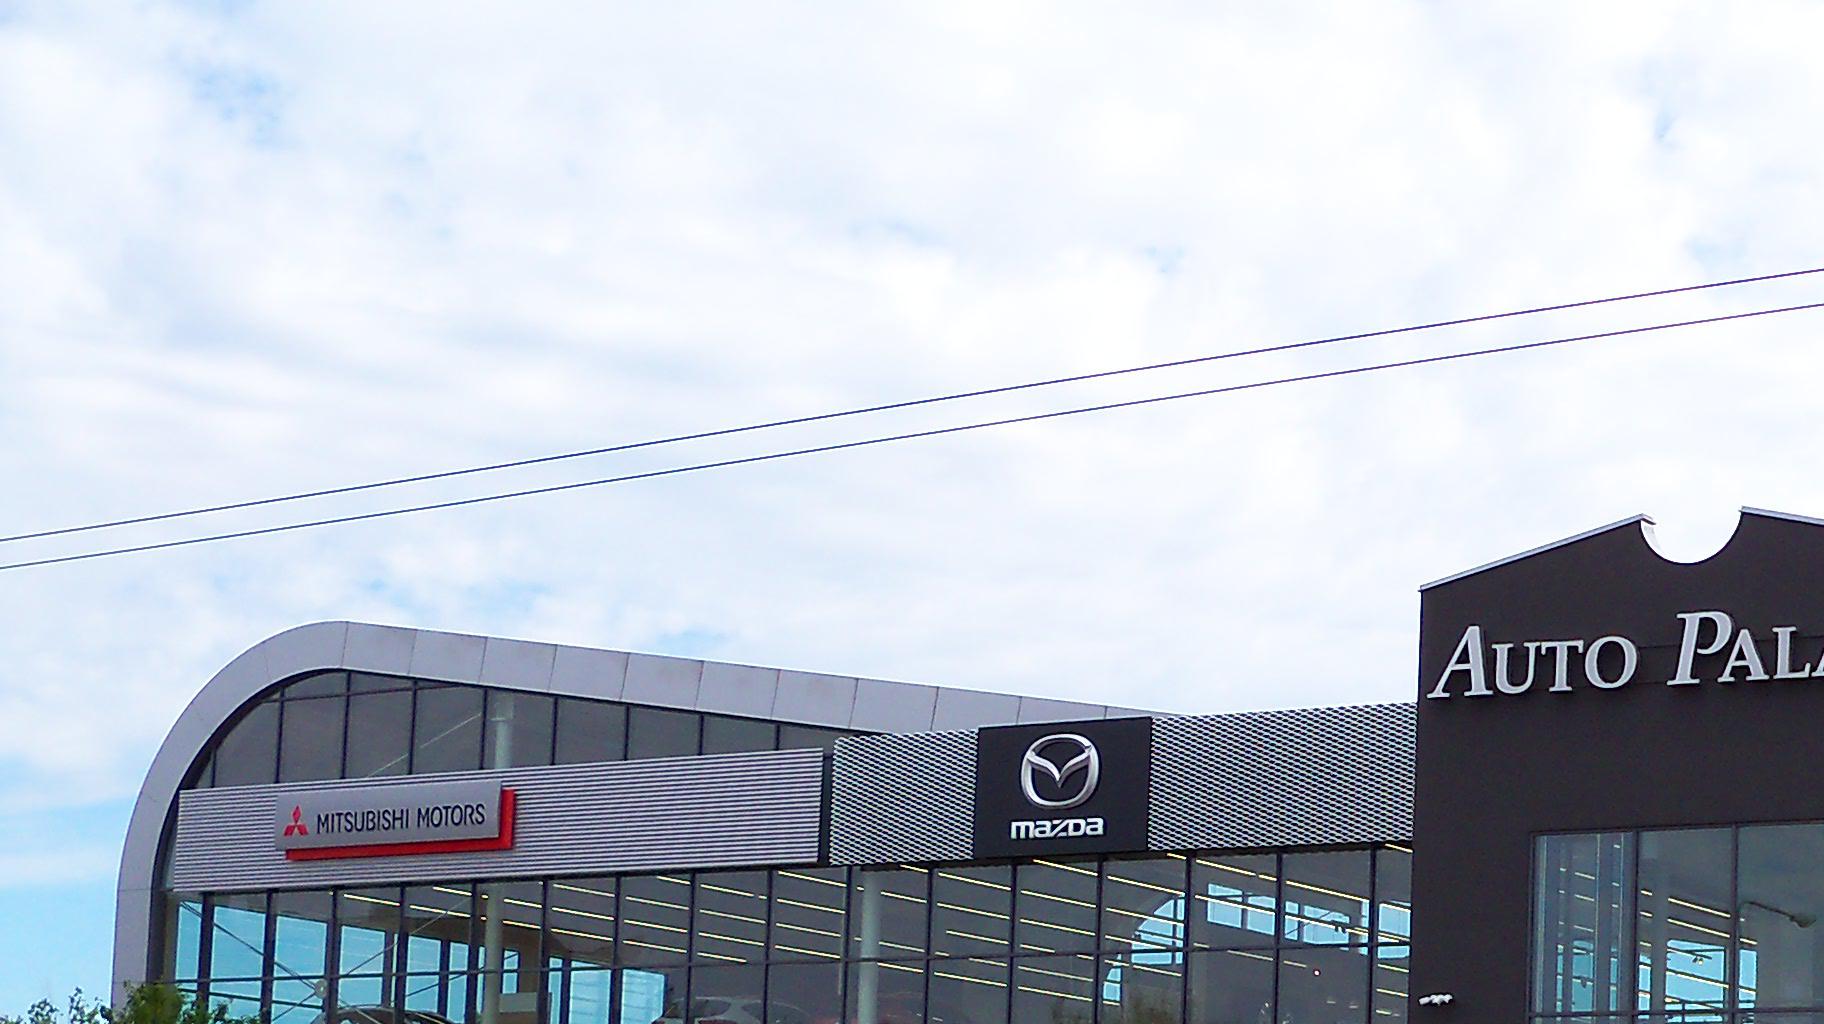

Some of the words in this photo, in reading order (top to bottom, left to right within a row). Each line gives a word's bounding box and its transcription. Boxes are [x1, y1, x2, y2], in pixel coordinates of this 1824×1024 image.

[1426, 625, 1638, 699] AUTO
[316, 808, 409, 834] MITSUBISHI
[417, 803, 486, 829] MOTORS
